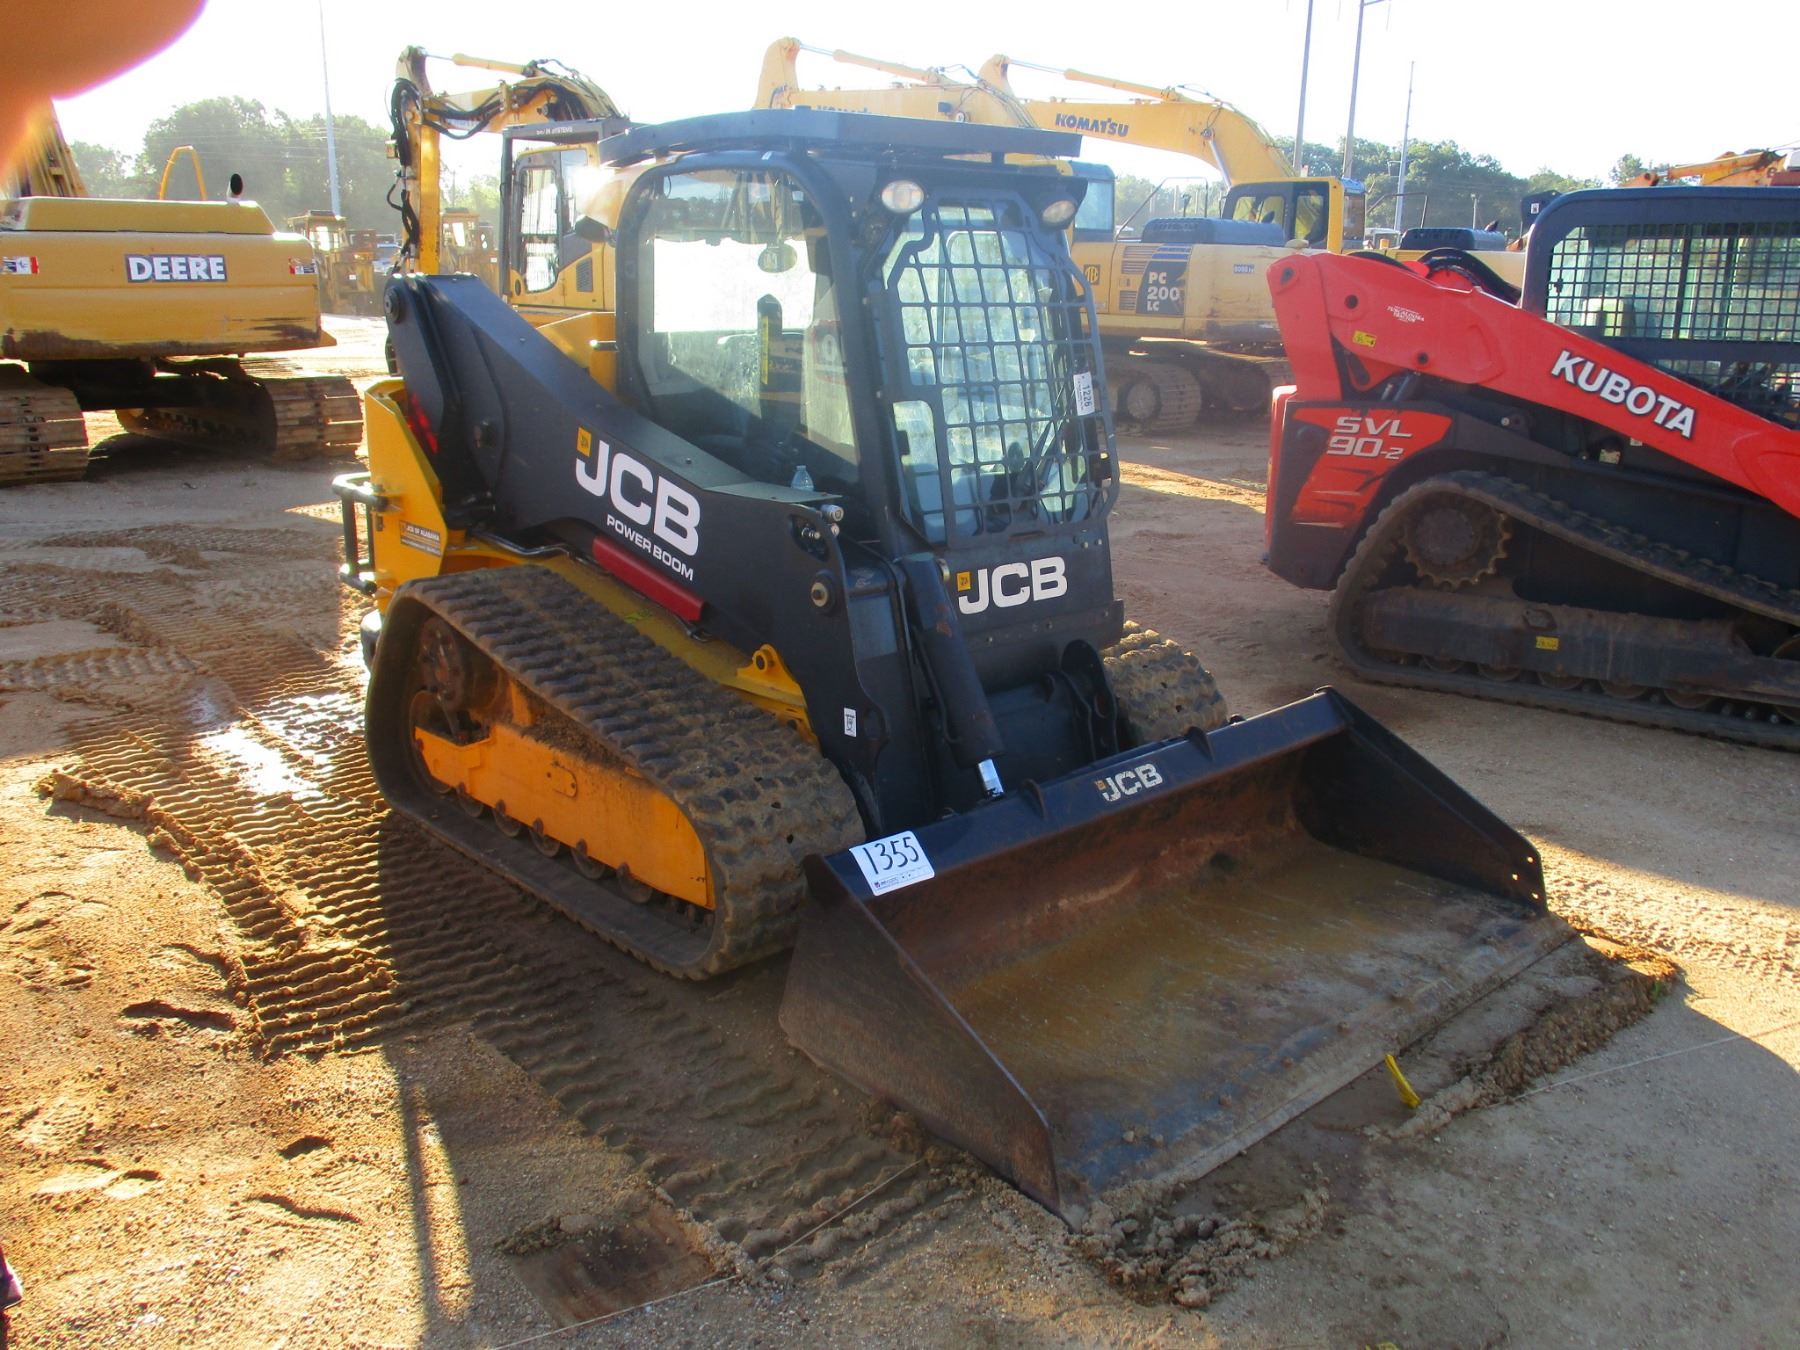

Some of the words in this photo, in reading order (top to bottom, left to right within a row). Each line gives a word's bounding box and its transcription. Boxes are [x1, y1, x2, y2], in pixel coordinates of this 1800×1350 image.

[1055, 113, 1129, 137] KOMATSU
[128, 257, 225, 281] DEERE
[1148, 271, 1167, 284] PC
[1147, 286, 1180, 301] 200
[1147, 300, 1160, 312] LC
[1551, 350, 1696, 439] KUBOTA
[1334, 416, 1413, 438] SVL
[1326, 436, 1404, 460] 90-2
[576, 440, 700, 556] JCB
[607, 514, 652, 553] POWER
[653, 544, 694, 581] BOOM
[959, 556, 1067, 615] JCB
[1102, 763, 1163, 802] JCB
[862, 836, 919, 875] 1355
